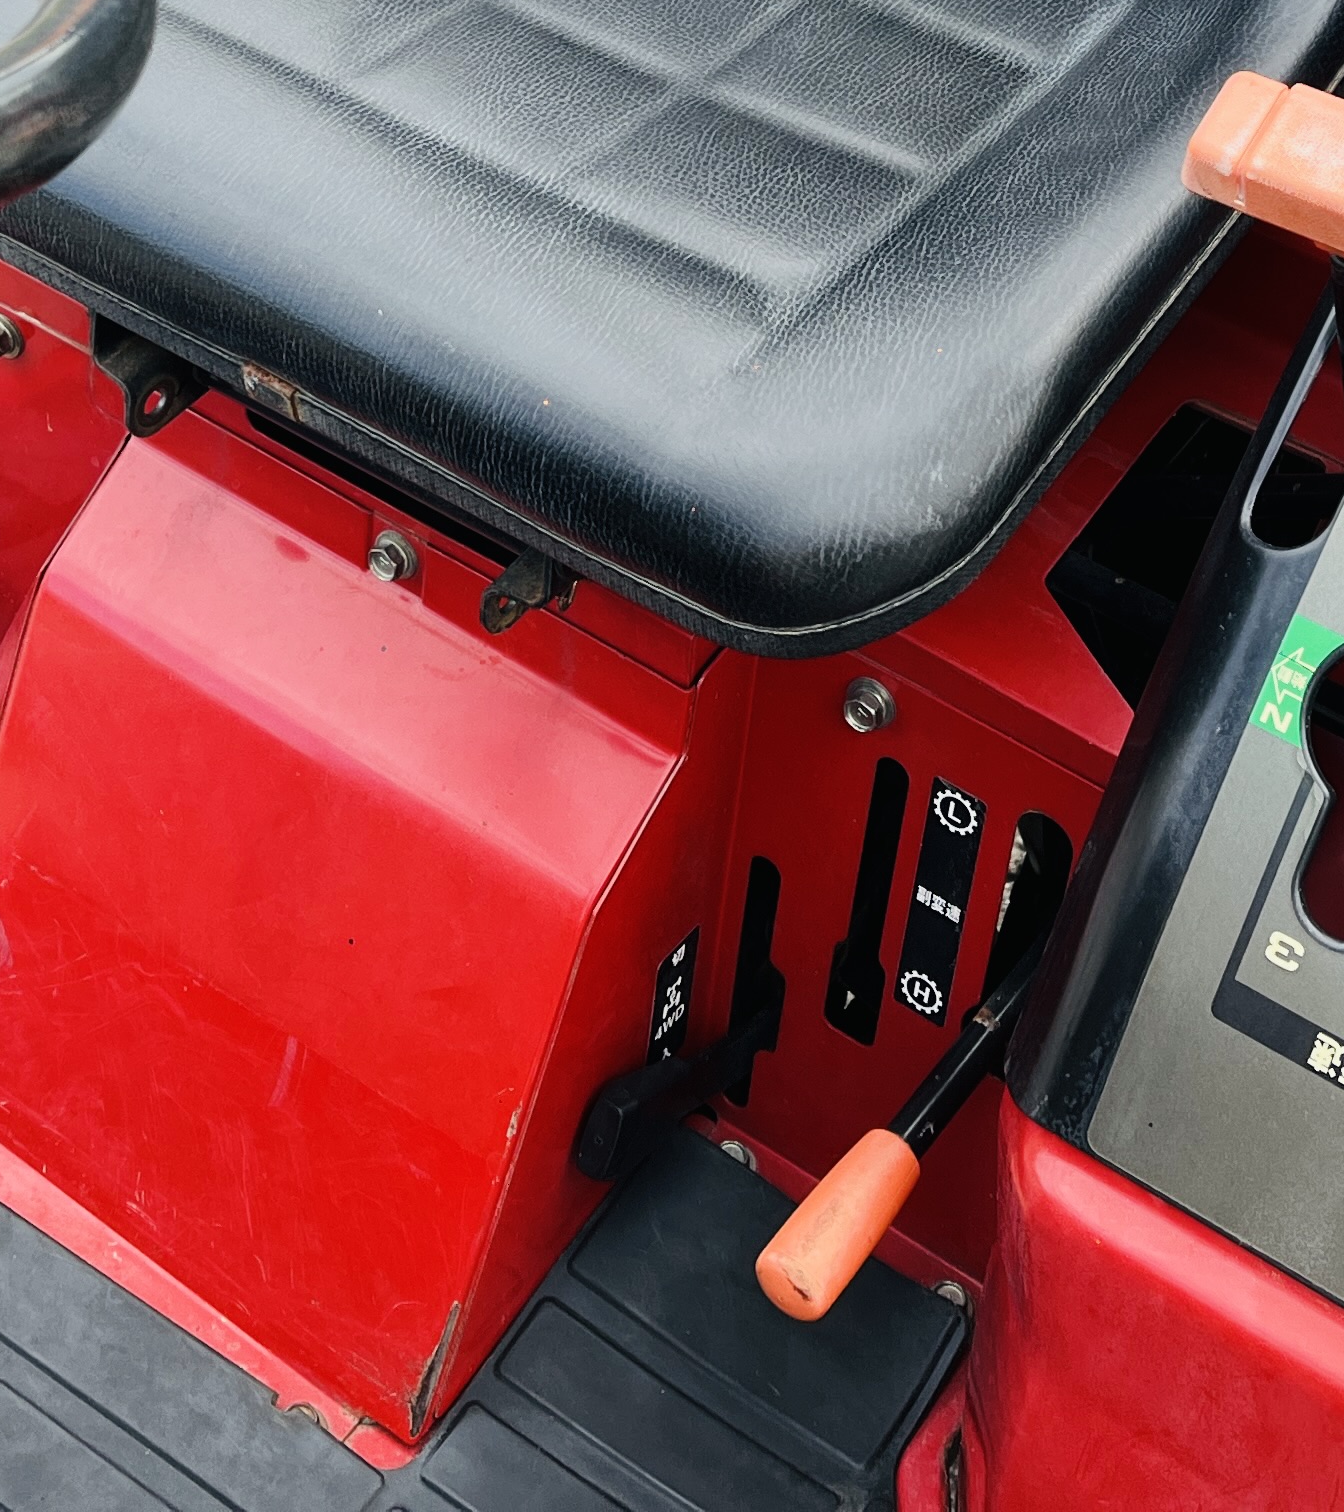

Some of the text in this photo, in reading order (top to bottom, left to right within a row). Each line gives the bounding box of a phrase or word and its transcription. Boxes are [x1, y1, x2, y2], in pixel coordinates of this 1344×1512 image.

[1259, 701, 1293, 734] N
[947, 800, 962, 824] L
[915, 884, 962, 924] 副変速
[1264, 930, 1305, 972] 3
[913, 980, 931, 1005] H
[654, 1003, 685, 1041] 4WD
